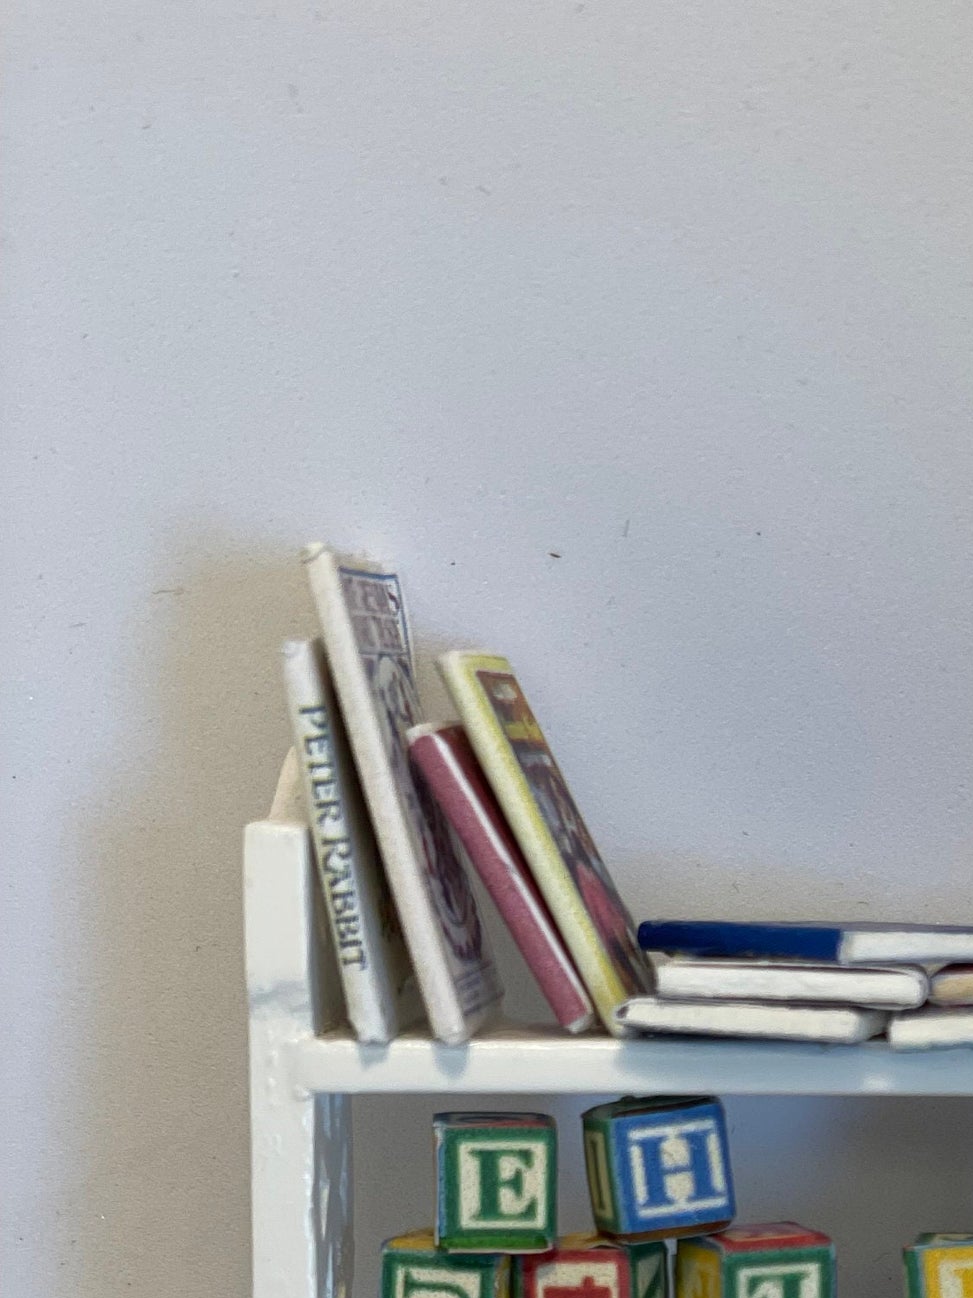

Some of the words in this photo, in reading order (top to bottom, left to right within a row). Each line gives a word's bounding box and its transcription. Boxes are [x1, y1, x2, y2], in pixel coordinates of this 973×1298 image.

[299, 705, 344, 825] PETER
[320, 836, 367, 971] RABBIT
[470, 1147, 536, 1222] E
[633, 1128, 726, 1212] H
